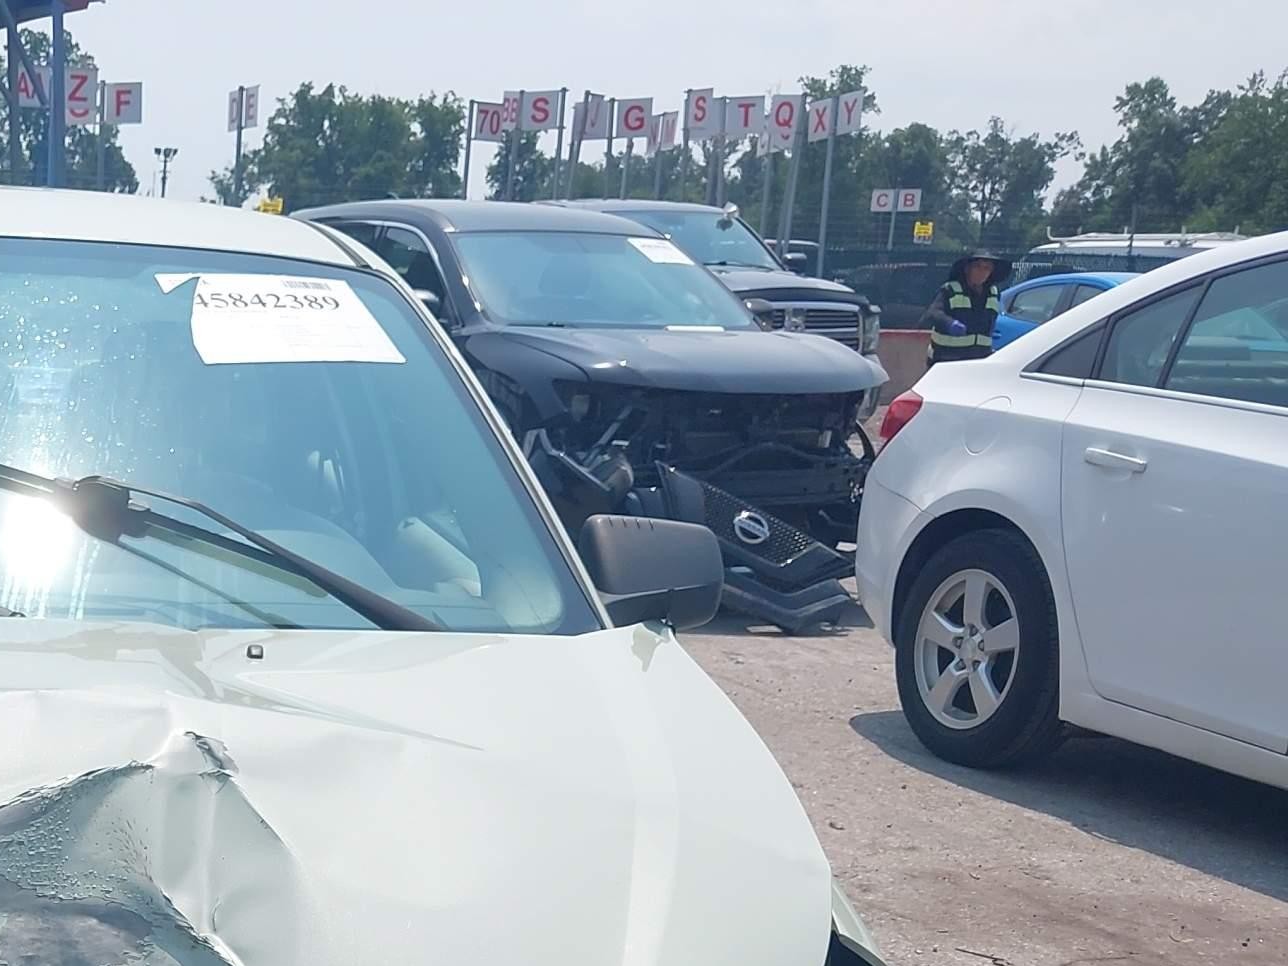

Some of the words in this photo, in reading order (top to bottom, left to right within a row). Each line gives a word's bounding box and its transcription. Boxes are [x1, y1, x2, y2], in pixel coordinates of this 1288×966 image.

[68, 75, 88, 102] Z
[116, 89, 132, 117] F
[247, 93, 255, 120] E
[531, 97, 549, 123] S
[694, 96, 706, 122] S
[737, 103, 756, 128] T
[775, 101, 794, 128] Q
[814, 106, 827, 133] X
[844, 98, 858, 125] Y
[478, 109, 500, 135] 70
[624, 105, 645, 131] G
[876, 193, 888, 207] C
[903, 193, 915, 207] B
[196, 293, 340, 311] 45842389
